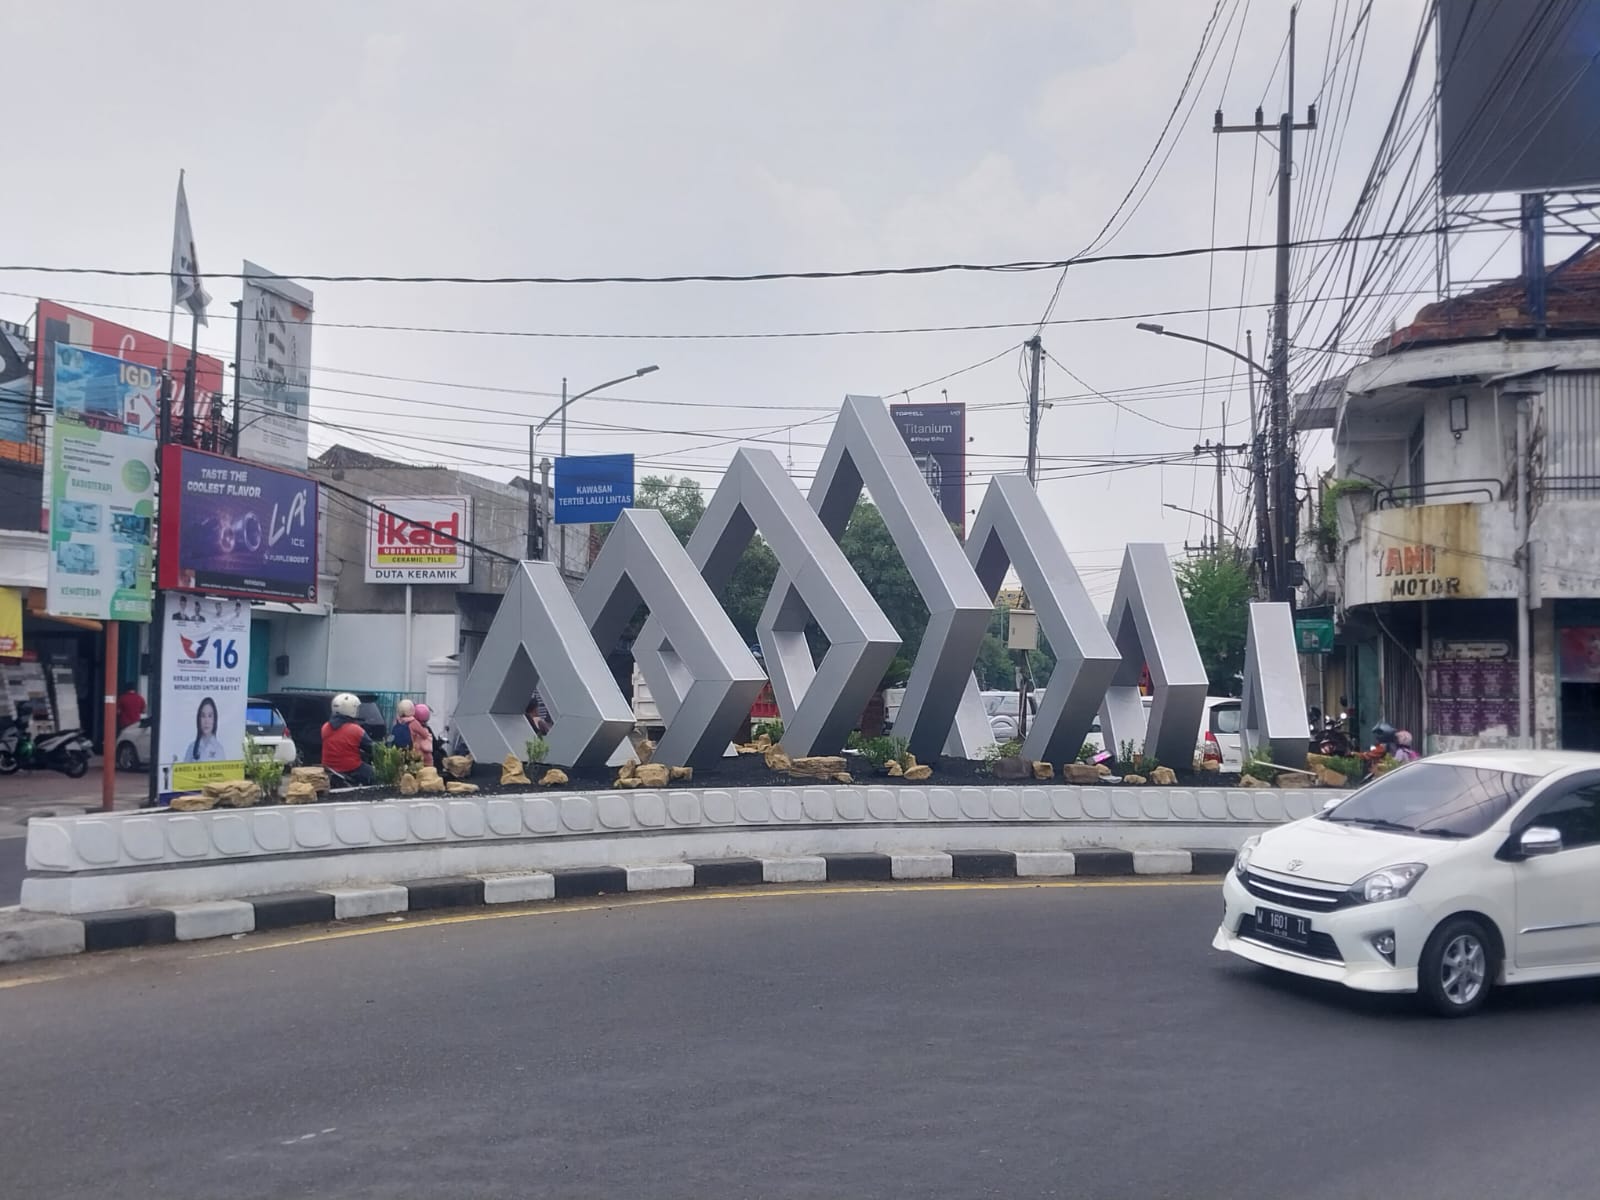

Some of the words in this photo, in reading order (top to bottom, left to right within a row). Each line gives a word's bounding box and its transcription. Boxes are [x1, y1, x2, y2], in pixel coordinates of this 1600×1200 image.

[120, 363, 152, 389] IGD
[903, 423, 953, 434] Titanium
[201, 468, 228, 481] TASTE
[230, 470, 248, 482] THE
[187, 481, 225, 495] COOLEST
[227, 484, 262, 498] FLAVOR
[576, 485, 613, 495] KAWASAN
[558, 497, 585, 506] TERTIB
[585, 496, 604, 505] LALU
[605, 495, 631, 504] LINTAS
[291, 537, 305, 548] ICE
[384, 547, 407, 555] UBIN
[410, 547, 451, 555] KERAMIK
[392, 556, 424, 564] CERAMIC
[426, 556, 443, 564] TILE
[375, 570, 404, 579] DUTA
[407, 570, 457, 579] KERAMIK
[1392, 576, 1460, 596] MOTOR
[212, 638, 239, 670] 16
[1270, 912, 1288, 931] 1601
[1297, 918, 1308, 935] TL
